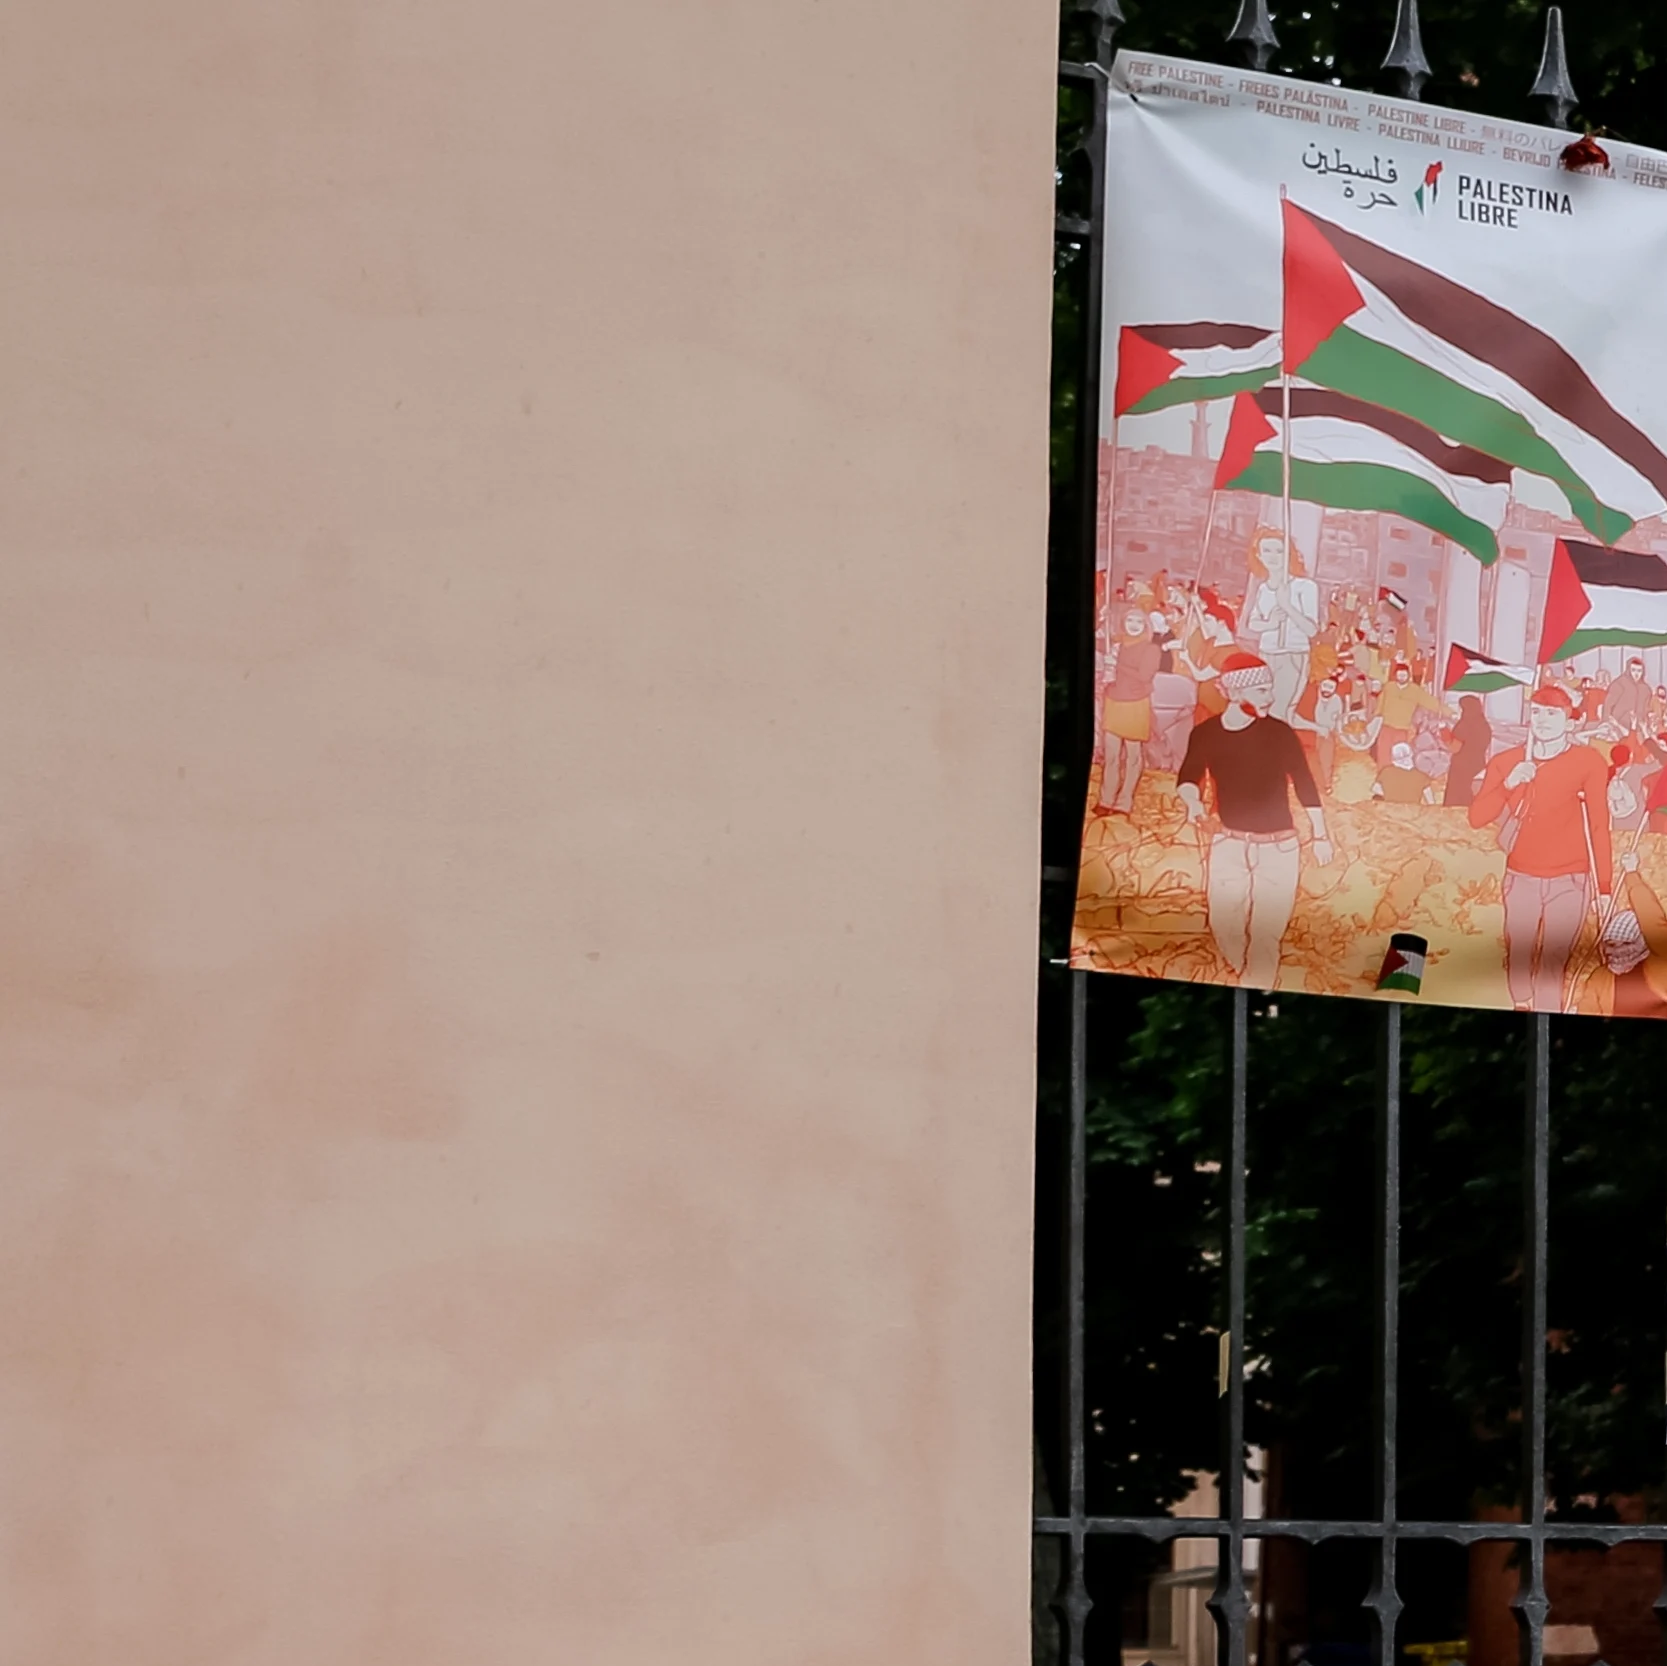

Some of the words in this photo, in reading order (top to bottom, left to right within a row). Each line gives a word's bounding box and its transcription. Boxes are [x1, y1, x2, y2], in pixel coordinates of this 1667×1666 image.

[1127, 60, 1154, 78] FREE
[1158, 65, 1225, 90] PALESTINE
[1238, 80, 1280, 99] FREIES
[1367, 103, 1430, 129] PALESTINE
[1433, 116, 1467, 135] LIBRE
[1256, 100, 1321, 125] PALESTINA
[1327, 114, 1360, 132] LIVRE
[1378, 122, 1441, 148] PALESTINA
[1301, 143, 1399, 184] فلسطين
[1342, 180, 1399, 211] حرة
[1458, 175, 1574, 216] PALESTINA
[1458, 200, 1519, 229] LIBRE
